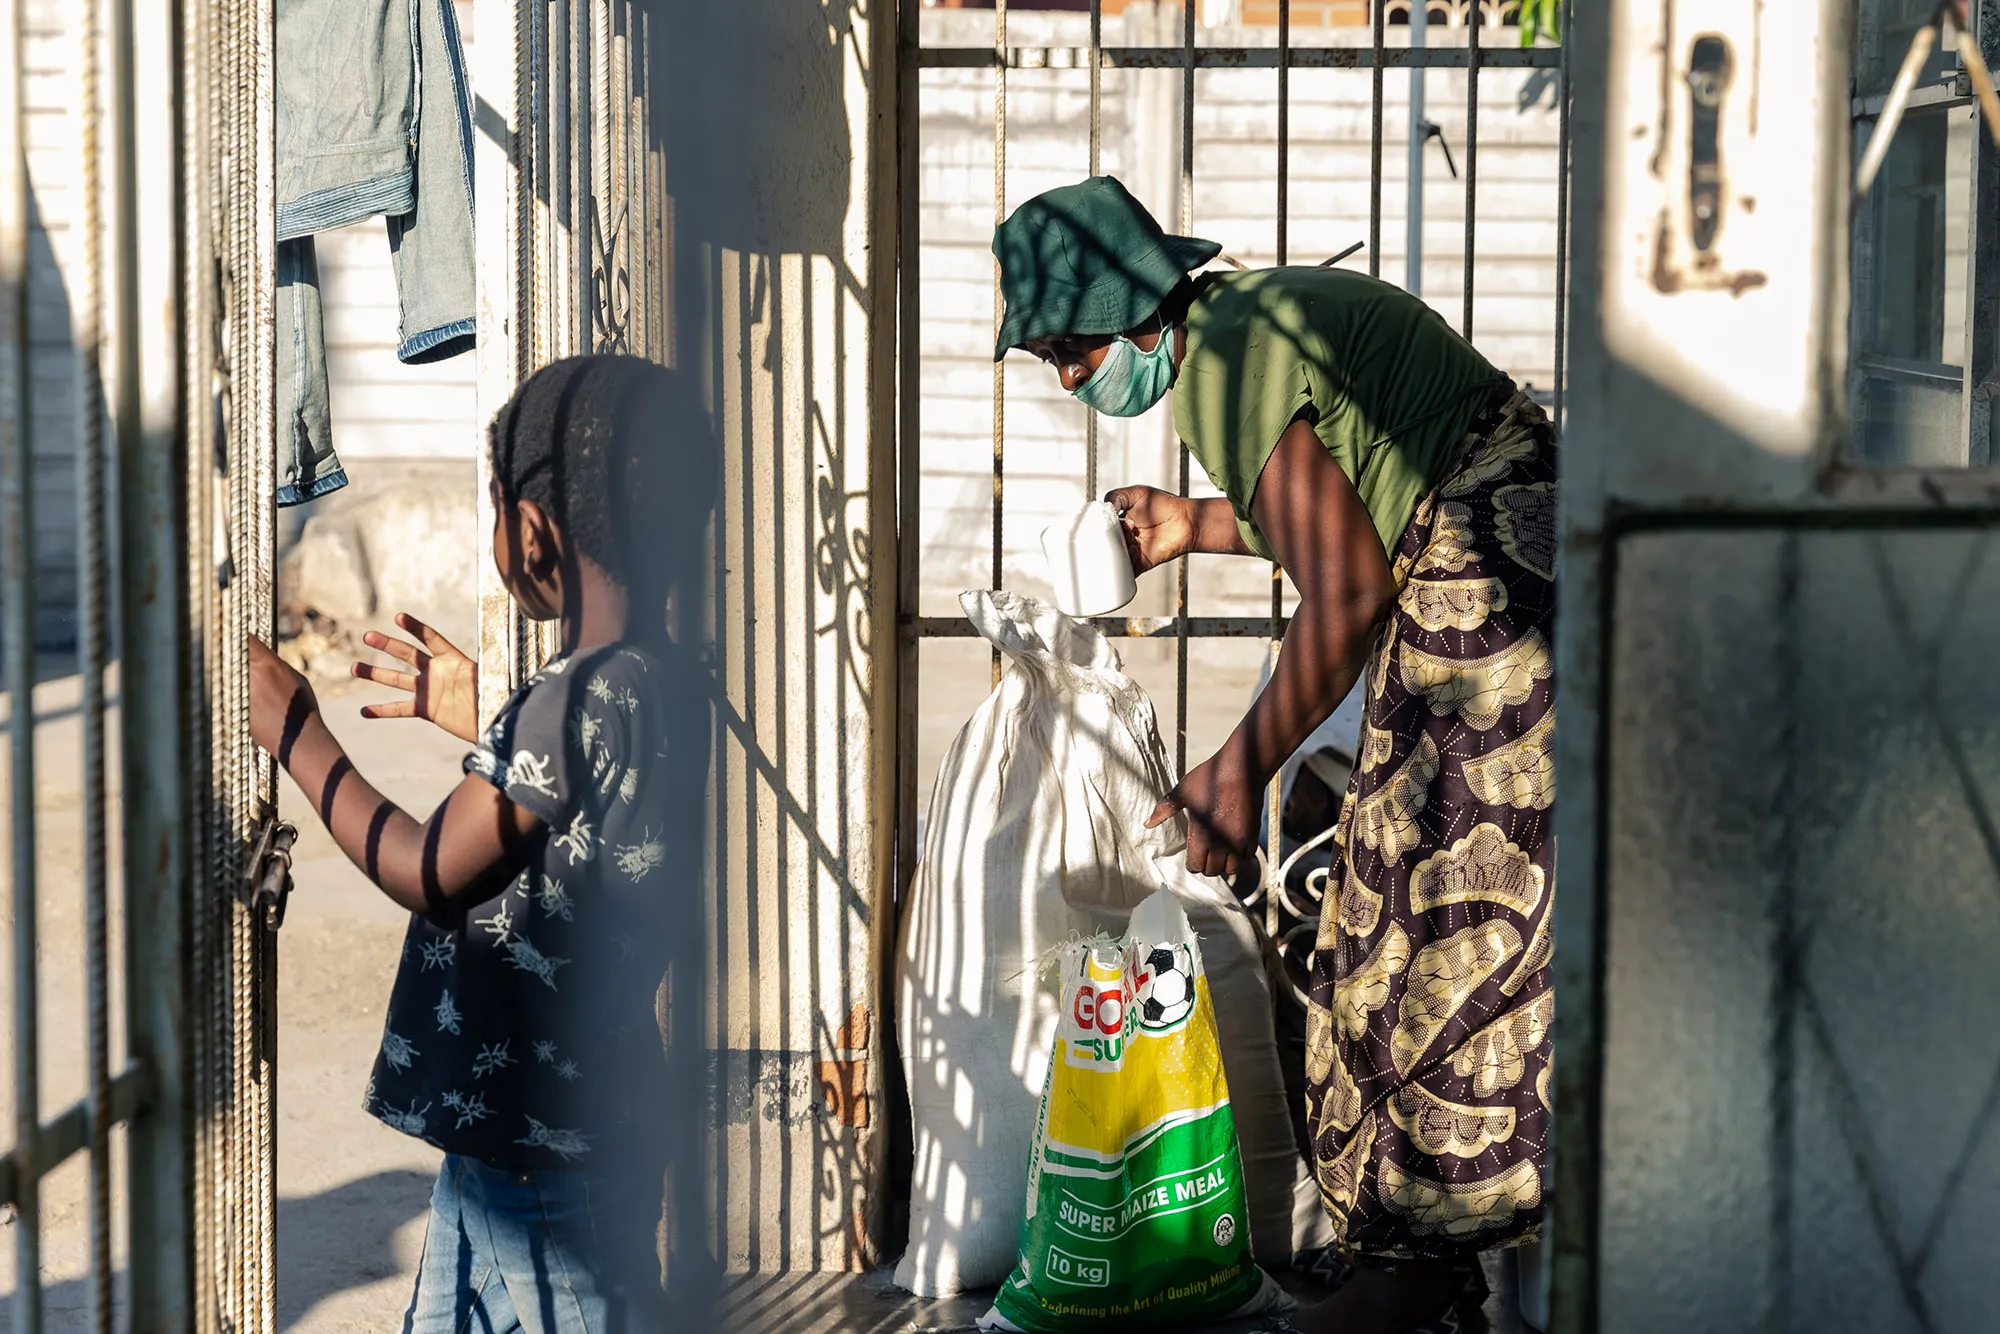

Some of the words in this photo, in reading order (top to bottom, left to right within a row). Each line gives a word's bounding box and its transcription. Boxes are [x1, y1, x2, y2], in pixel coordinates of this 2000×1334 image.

[1093, 1006, 1139, 1062] SUER
[1059, 1200, 1116, 1233] SUPER
[1120, 1185, 1170, 1228] MAIZE
[1174, 1167, 1226, 1203] MEAL
[1051, 1253, 1071, 1276] 10
[1077, 1263, 1104, 1283] kg
[1110, 1303, 1130, 1315] the
[1133, 1297, 1150, 1313] Art
[1153, 1290, 1164, 1304] of
[1167, 1280, 1208, 1300] Quality
